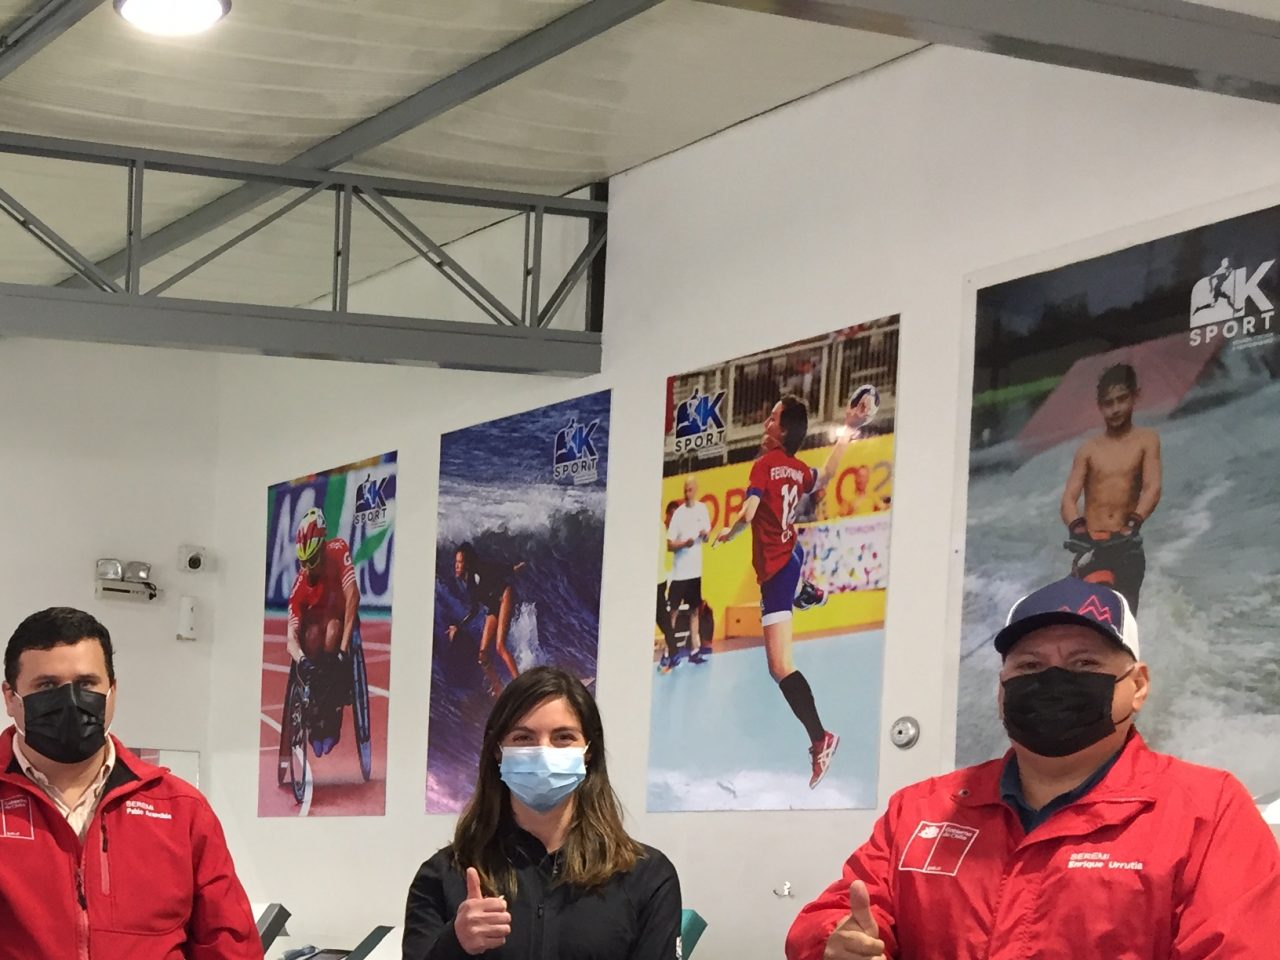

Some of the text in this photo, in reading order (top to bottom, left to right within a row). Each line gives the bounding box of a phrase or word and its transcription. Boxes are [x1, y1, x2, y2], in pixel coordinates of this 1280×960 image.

[1189, 311, 1275, 346] SPORT
[675, 430, 725, 452] SPORT
[555, 458, 597, 477] SPORT
[354, 507, 387, 524] SPORT
[1067, 860, 1143, 870] Enrique Urrutia
